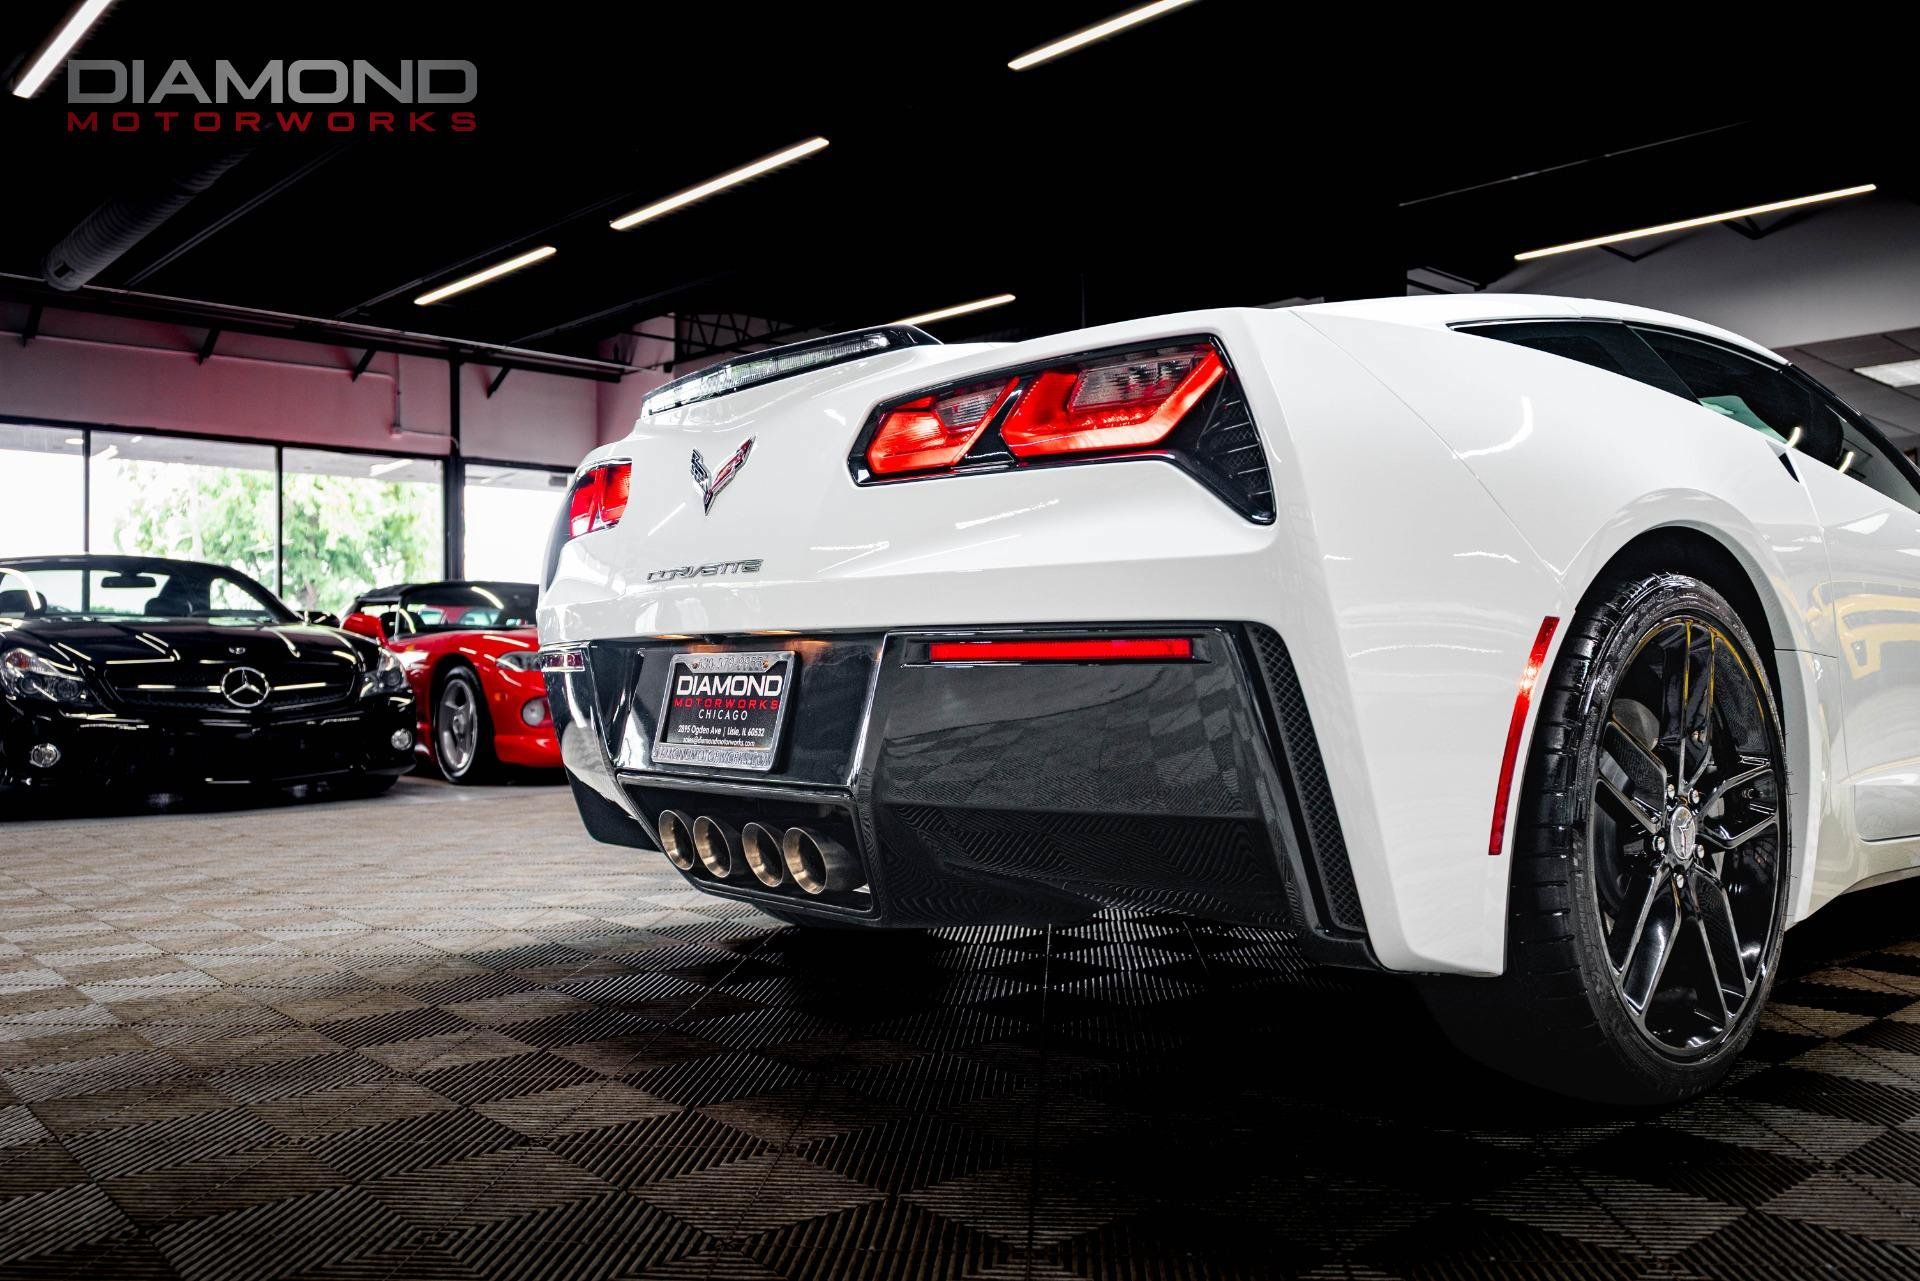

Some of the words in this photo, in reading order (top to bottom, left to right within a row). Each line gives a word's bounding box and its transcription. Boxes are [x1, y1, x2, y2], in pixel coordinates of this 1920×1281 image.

[646, 559, 764, 583] CORVETTE
[676, 675, 783, 696] DIAMOND
[674, 698, 780, 710] MOTORWORKS
[698, 709, 748, 720] CHICAGO
[691, 725, 709, 735] Ogden
[710, 726, 721, 734] Ave
[747, 728, 765, 737] 60532
